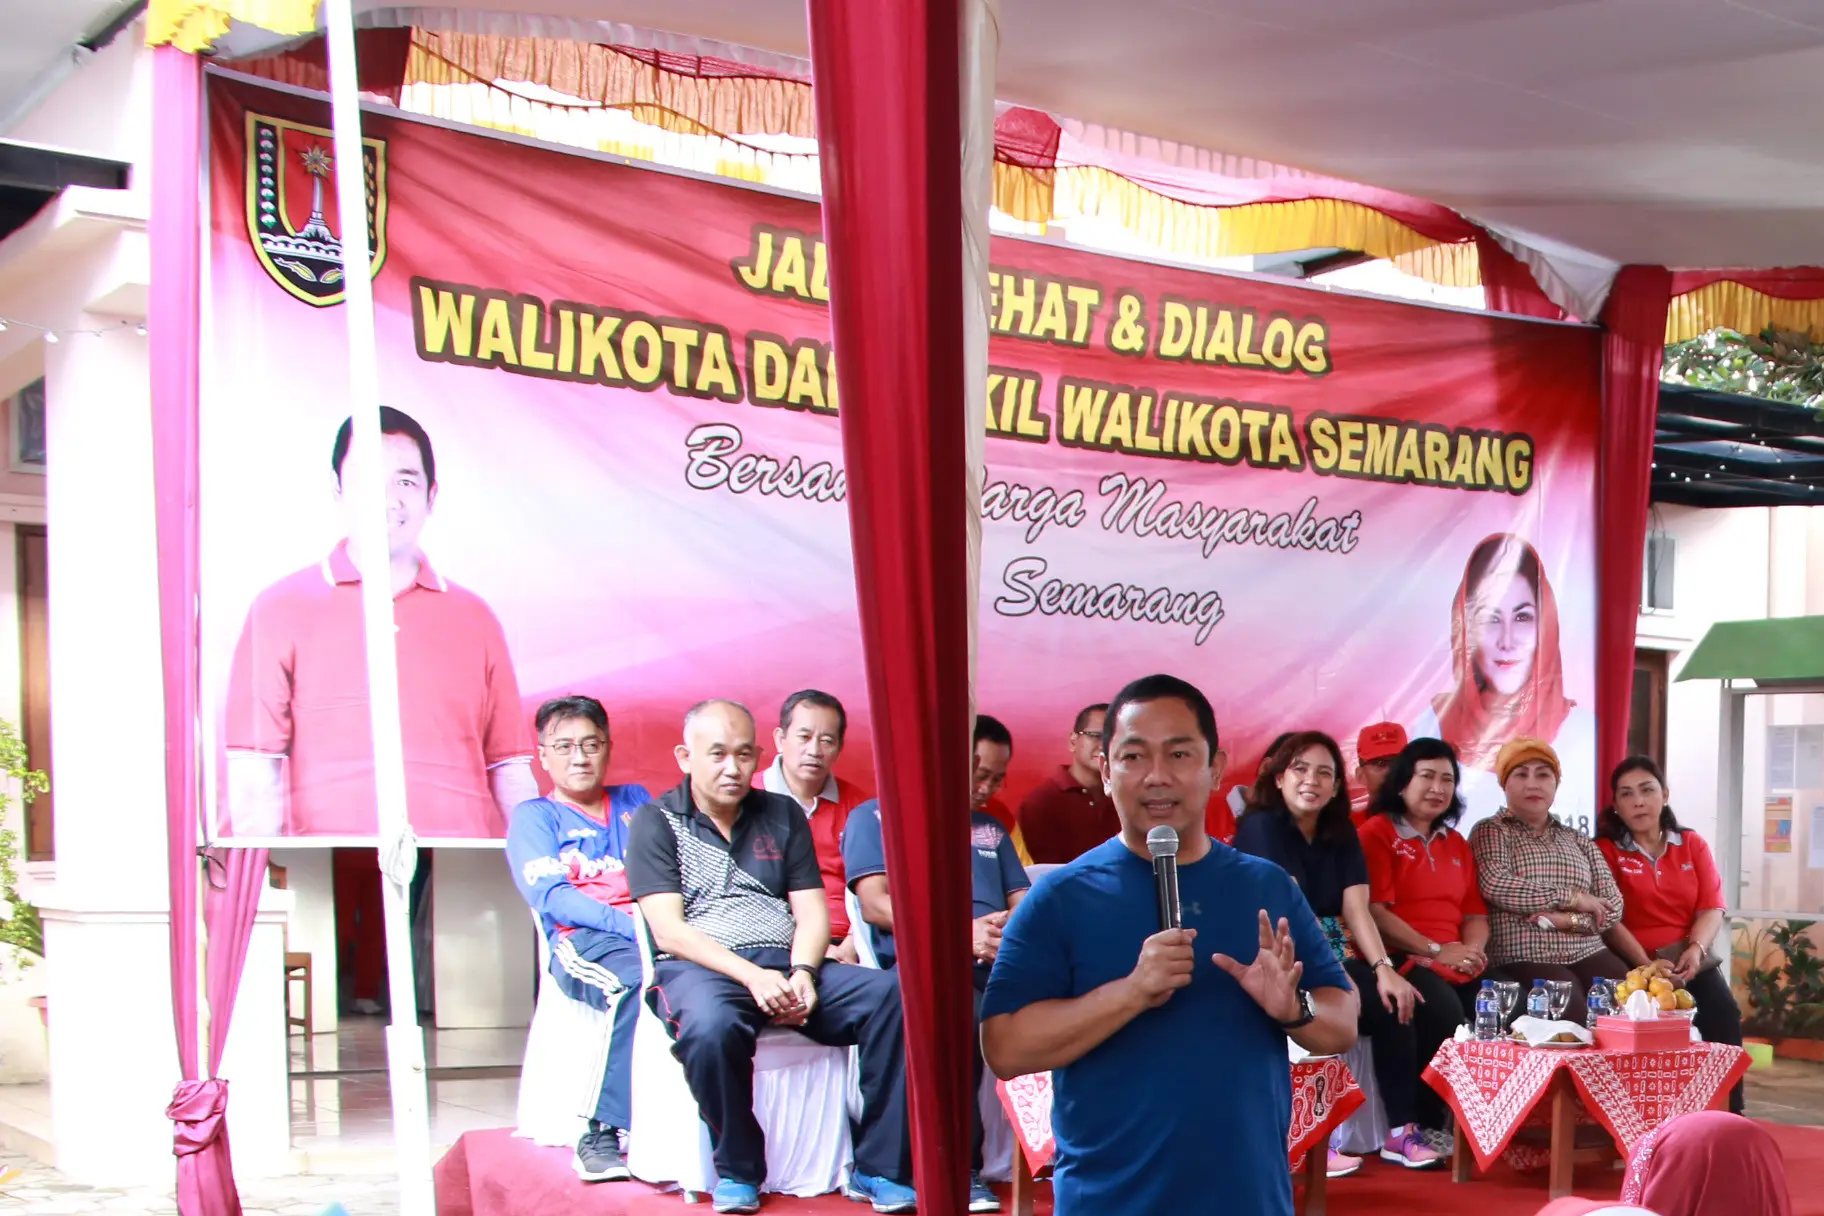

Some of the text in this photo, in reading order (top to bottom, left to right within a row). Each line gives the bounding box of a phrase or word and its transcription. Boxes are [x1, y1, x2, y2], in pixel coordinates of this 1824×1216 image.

[738, 231, 1328, 373] JAL HAT & DIALOG
[418, 285, 738, 395] WALIKOTA
[986, 372, 1046, 437] KIL
[1062, 384, 1301, 466] WALIKOTA
[1309, 417, 1532, 489] SEMARANG
[684, 422, 1362, 559] Bersa arga Masyarakat
[994, 556, 1225, 646] Semarang
